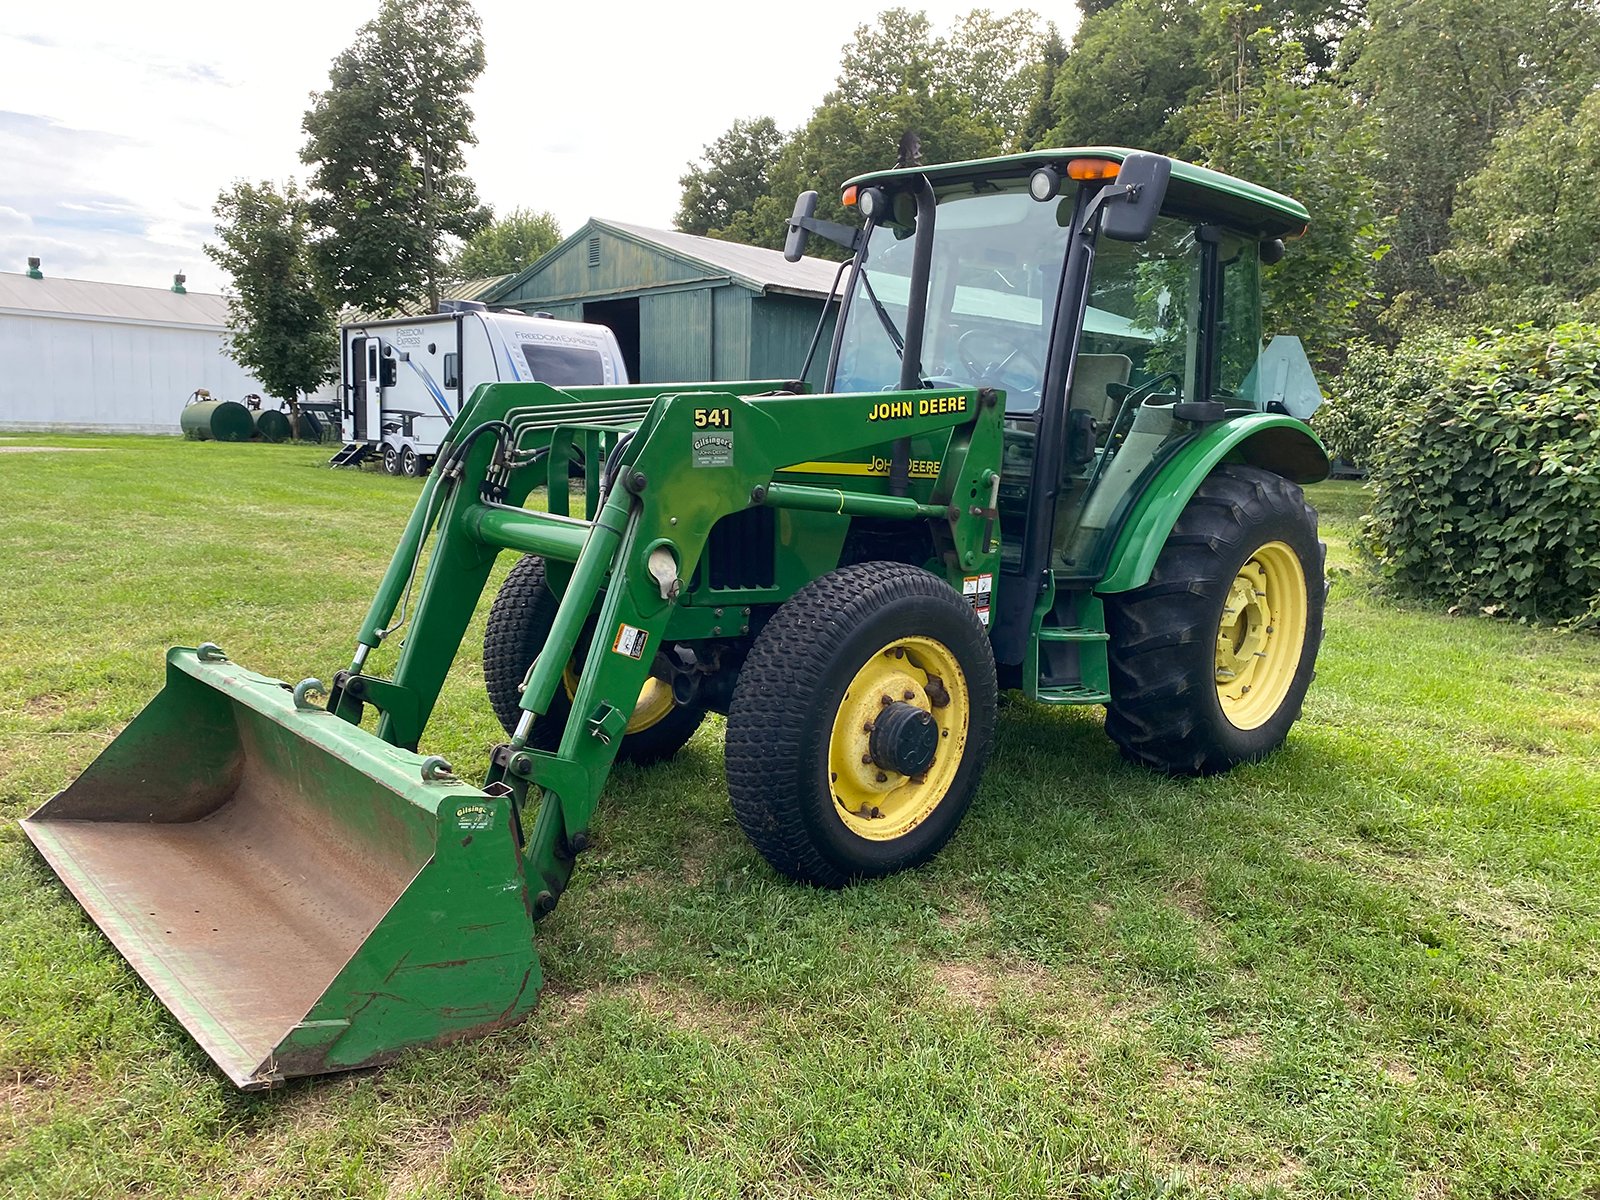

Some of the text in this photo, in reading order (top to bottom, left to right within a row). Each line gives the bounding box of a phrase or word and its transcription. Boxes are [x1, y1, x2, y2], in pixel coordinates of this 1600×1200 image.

[515, 332, 561, 341] FREEDOM
[868, 396, 967, 420] JOHN DEERE
[694, 407, 732, 429] 541
[867, 455, 893, 471] JOH
